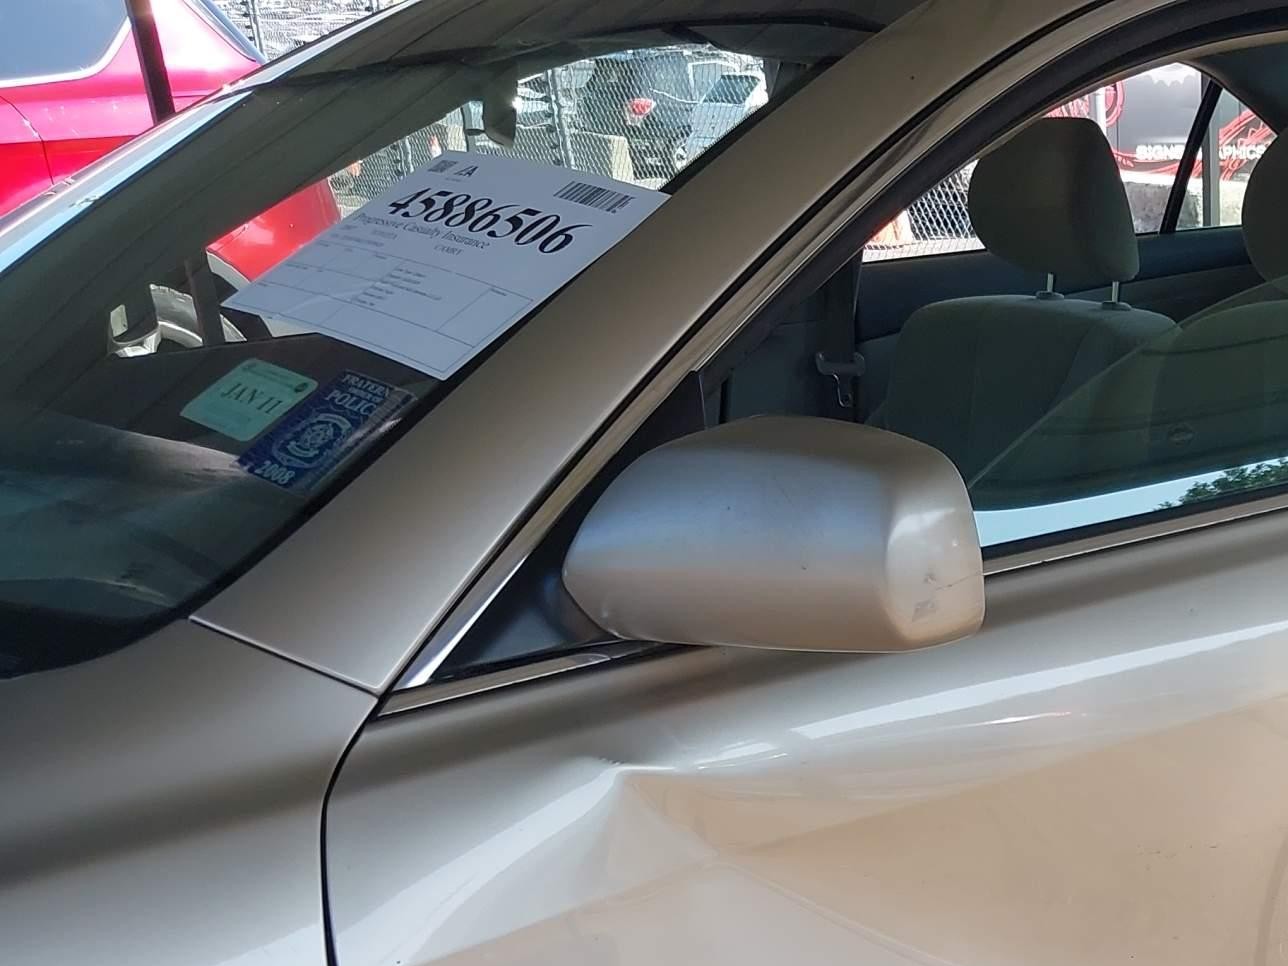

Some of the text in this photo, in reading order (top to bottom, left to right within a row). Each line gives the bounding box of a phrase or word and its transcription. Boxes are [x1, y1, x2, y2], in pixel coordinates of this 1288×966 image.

[388, 187, 593, 254] 45886506
[441, 229, 491, 249] Insurance
[220, 382, 283, 415] JAN 11
[325, 389, 377, 417] POLIC
[254, 460, 296, 485] 2008
